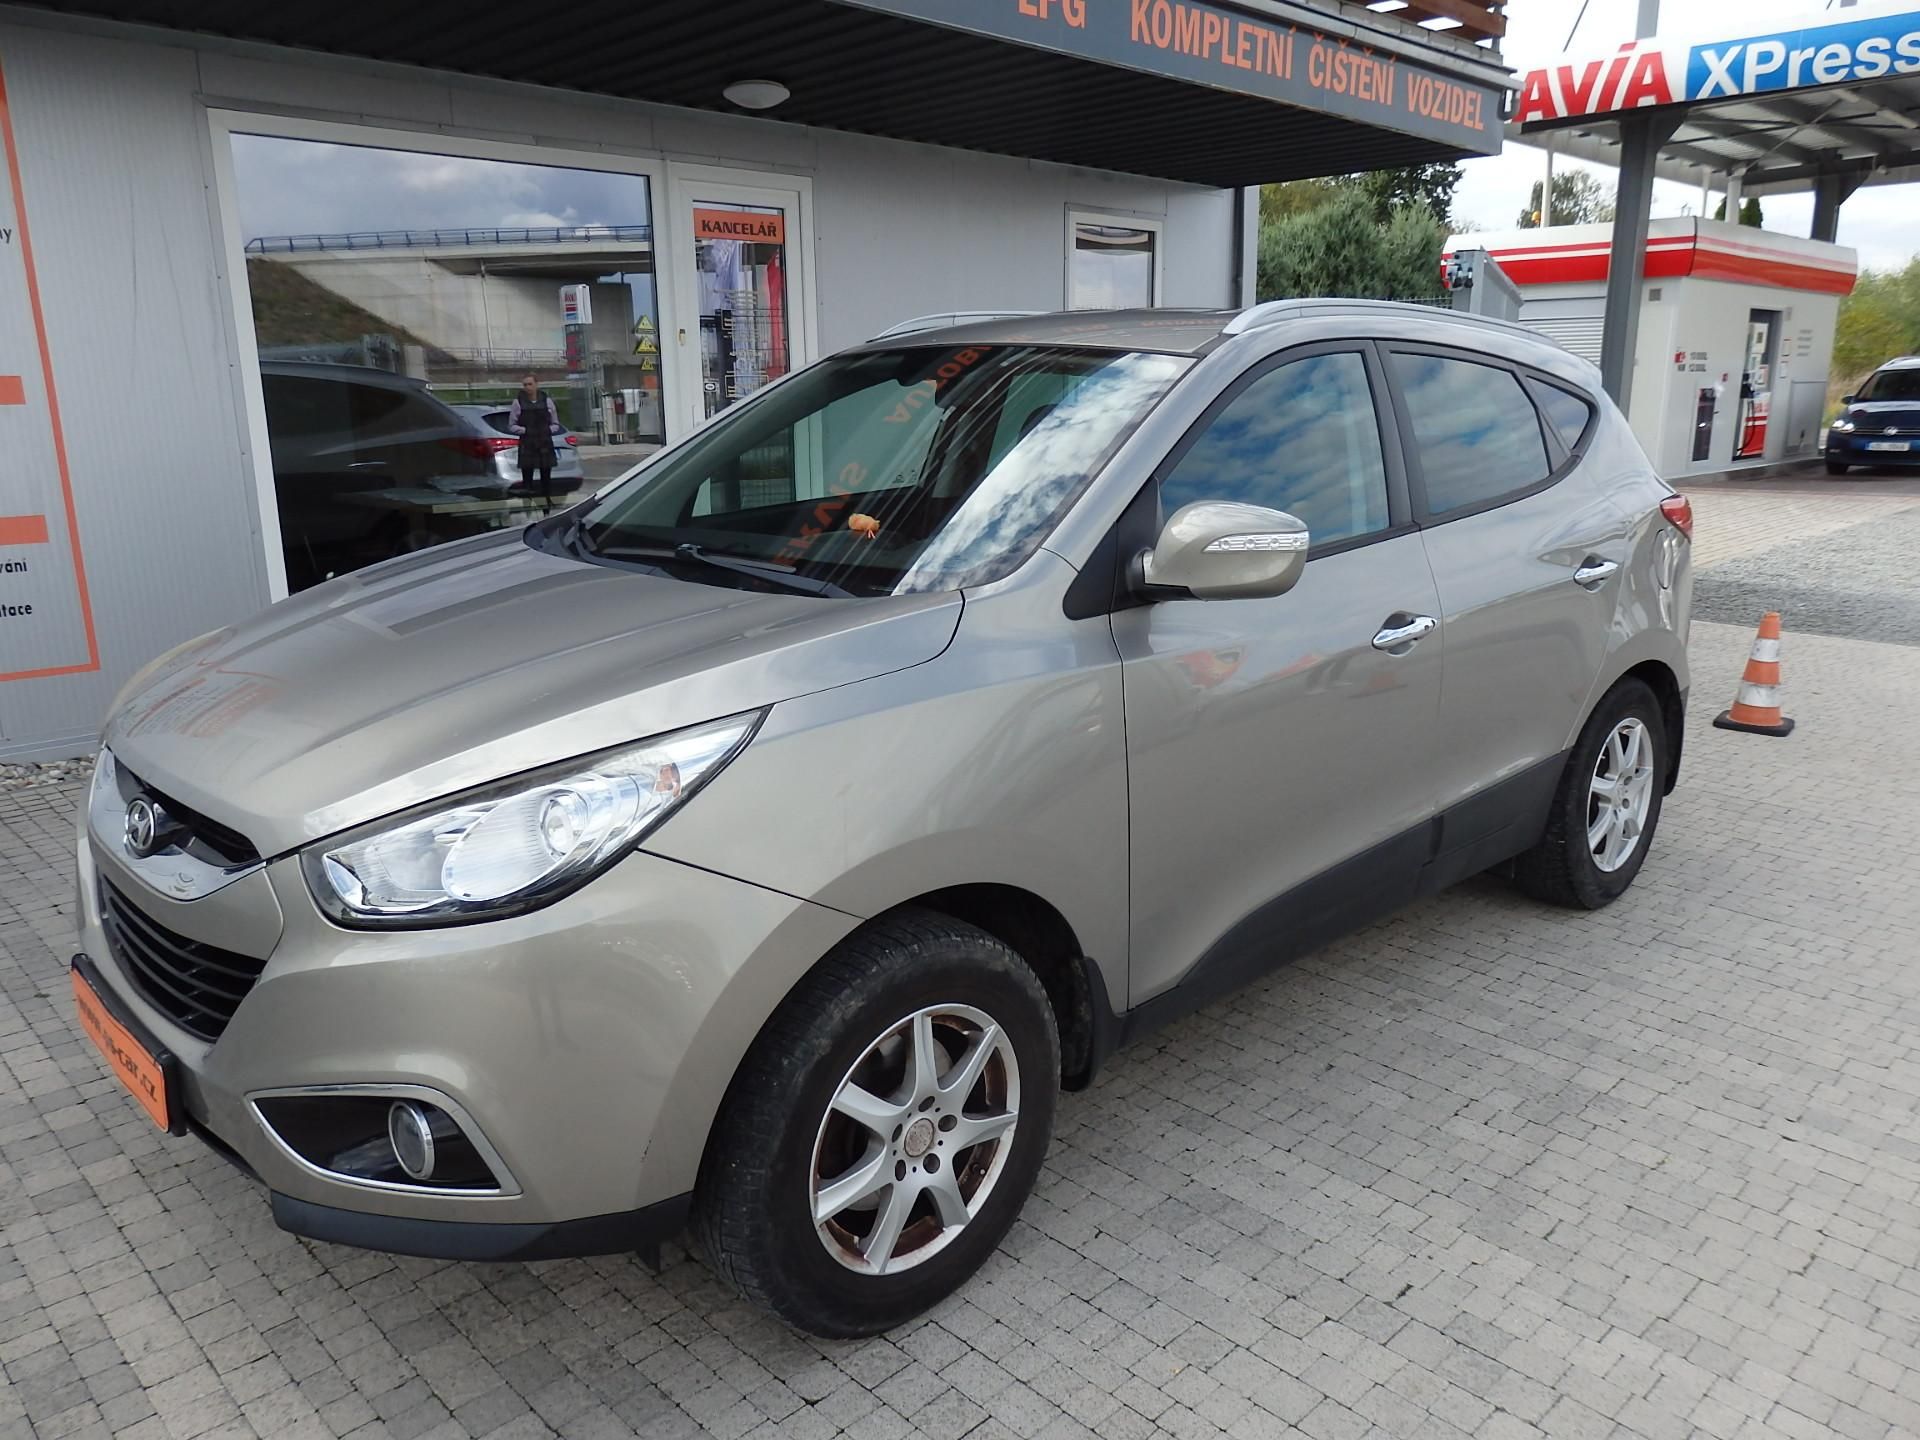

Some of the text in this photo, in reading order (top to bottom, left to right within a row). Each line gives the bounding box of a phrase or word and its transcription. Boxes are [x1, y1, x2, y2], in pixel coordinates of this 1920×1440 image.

[1130, 0, 1485, 131] KOMPLETNÍ ČIŠTĚNÍ VOZIDEL
[1696, 31, 1920, 100] XPress
[701, 219, 777, 237] KANCELÁŘ
[0, 604, 33, 618] tace
